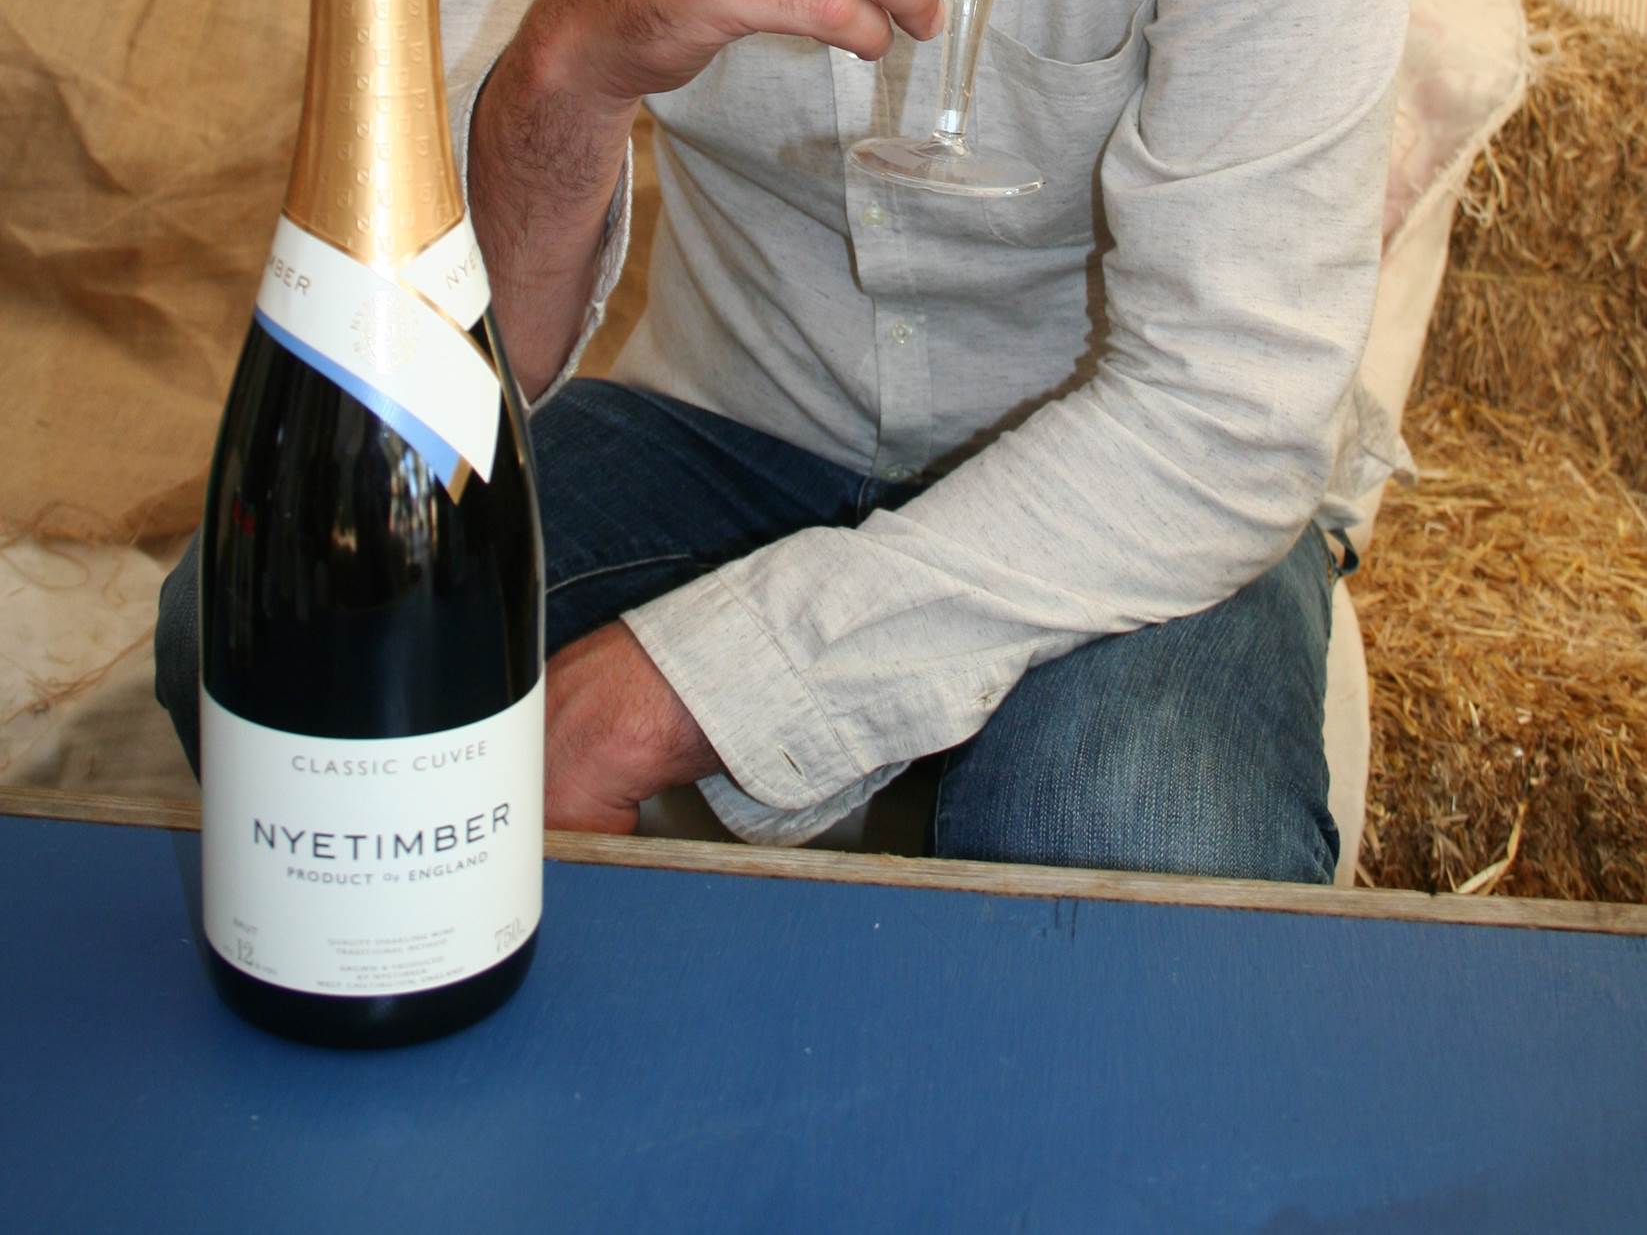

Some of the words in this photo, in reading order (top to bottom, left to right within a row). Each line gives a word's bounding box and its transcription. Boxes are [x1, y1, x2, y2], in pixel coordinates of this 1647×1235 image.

[292, 755, 398, 776] CLASSIC
[412, 741, 487, 771] CUVEE
[253, 802, 510, 860] NYETIMBER
[287, 866, 374, 885] PRODUCT
[408, 852, 488, 882] ENGLAND
